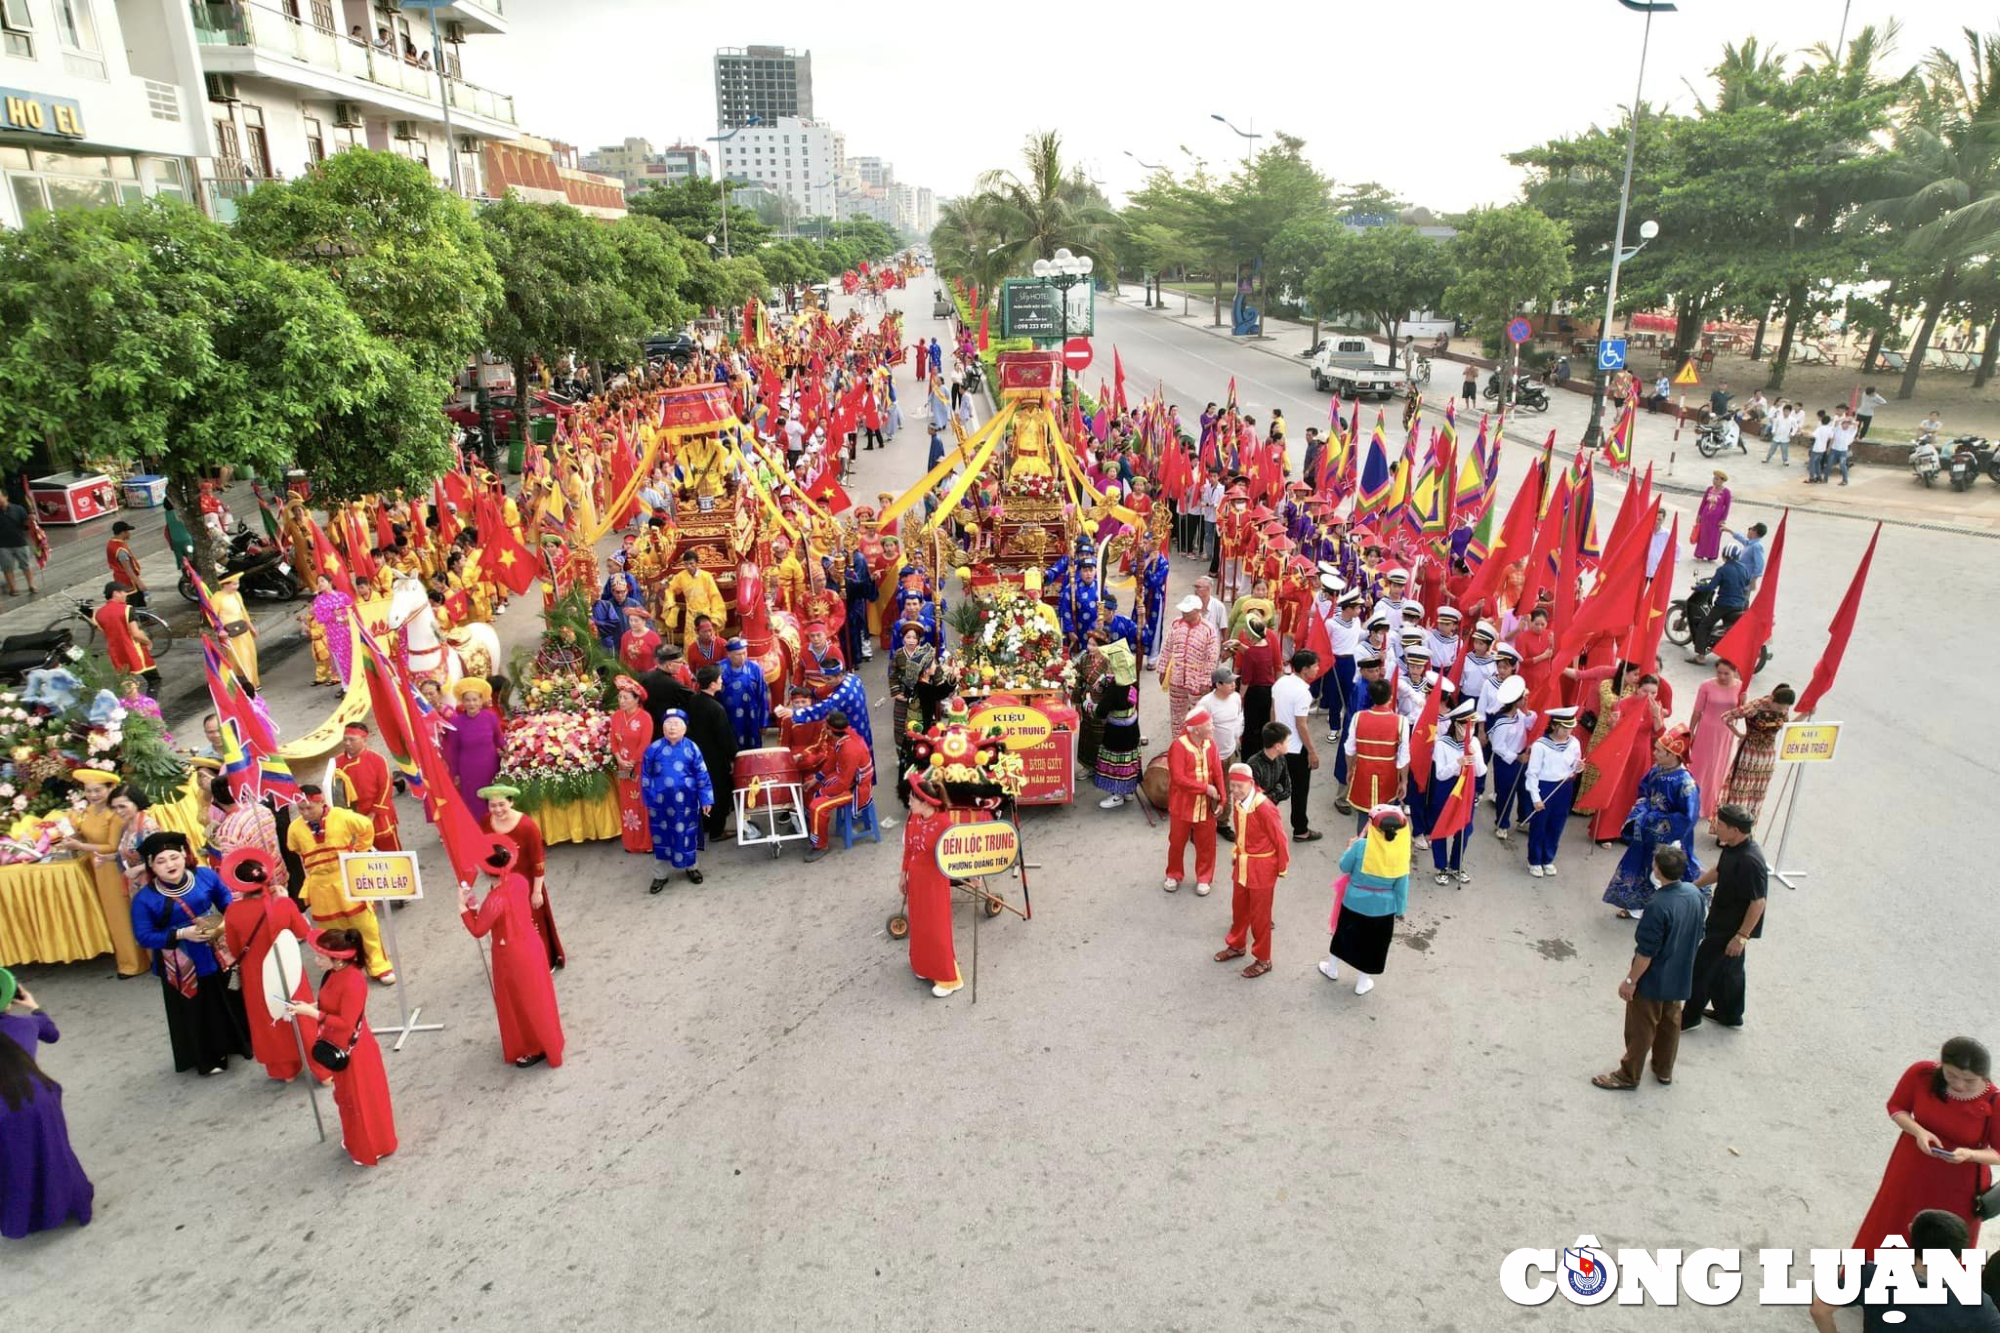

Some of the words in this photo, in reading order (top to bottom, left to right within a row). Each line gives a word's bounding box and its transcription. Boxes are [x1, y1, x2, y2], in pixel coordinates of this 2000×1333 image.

[993, 711, 1026, 723] KIỆU
[1017, 726, 1045, 736] TRUNG
[1046, 775, 1061, 784] 2023
[943, 831, 963, 855] ĐỀN
[964, 832, 982, 857] LỘC
[985, 831, 1015, 852] TRUNG
[355, 873, 374, 890] ĐỀN
